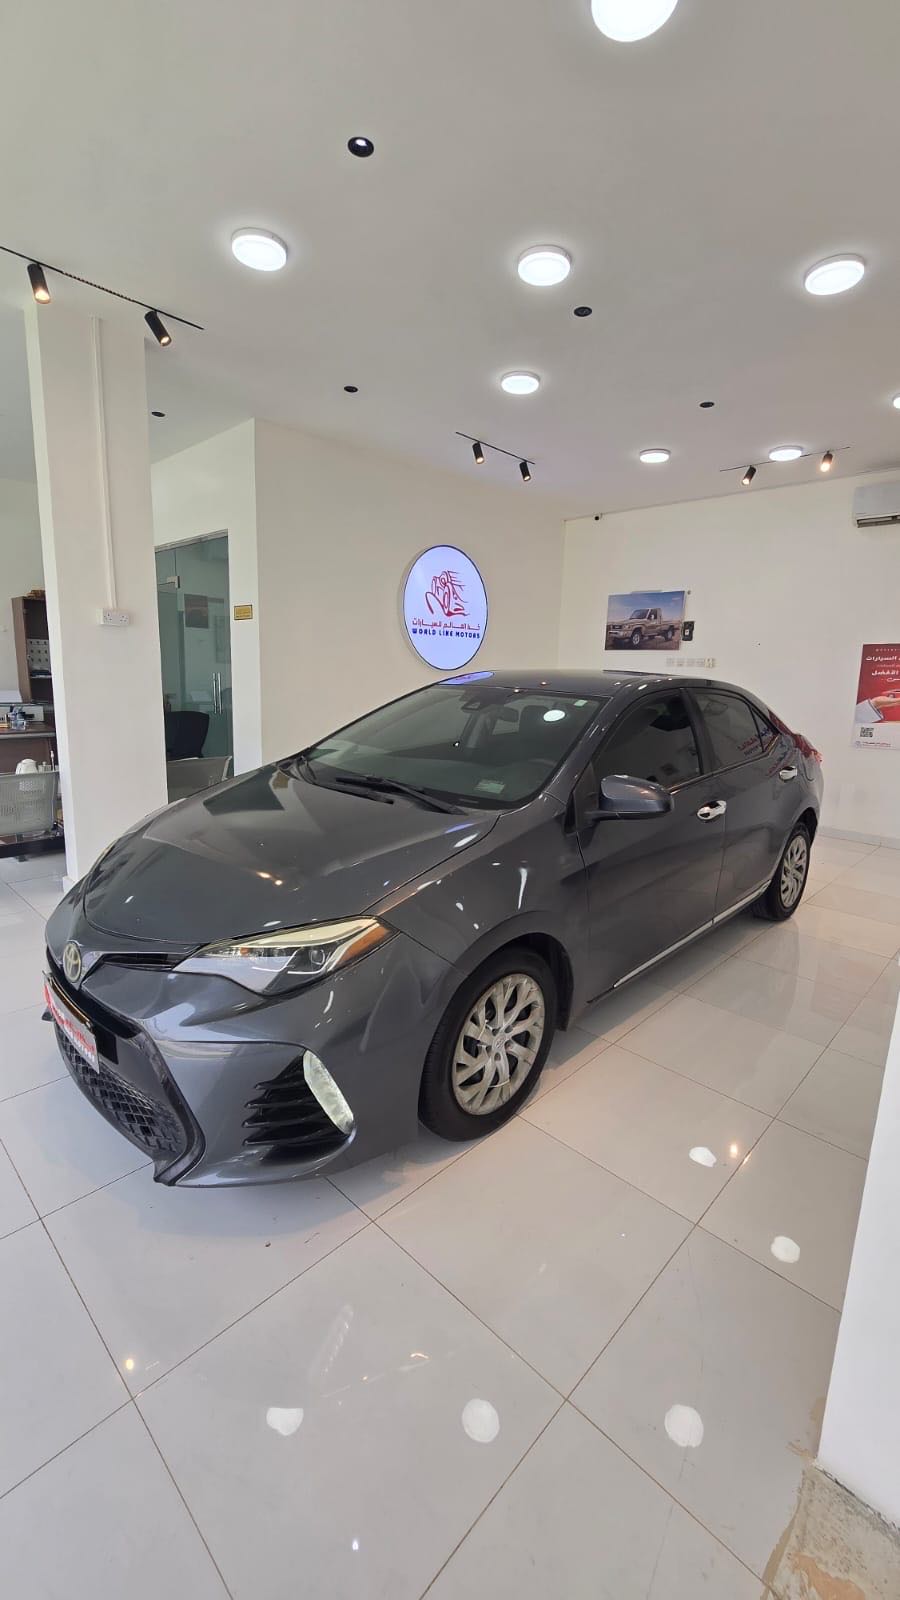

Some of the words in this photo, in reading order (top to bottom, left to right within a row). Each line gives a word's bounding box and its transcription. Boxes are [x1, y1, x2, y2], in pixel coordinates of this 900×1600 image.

[412, 617, 442, 628] للسيارات
[443, 621, 467, 631] العالم
[411, 628, 437, 636] WORLD
[439, 629, 453, 637] LINE
[455, 630, 480, 639] MOTORS
